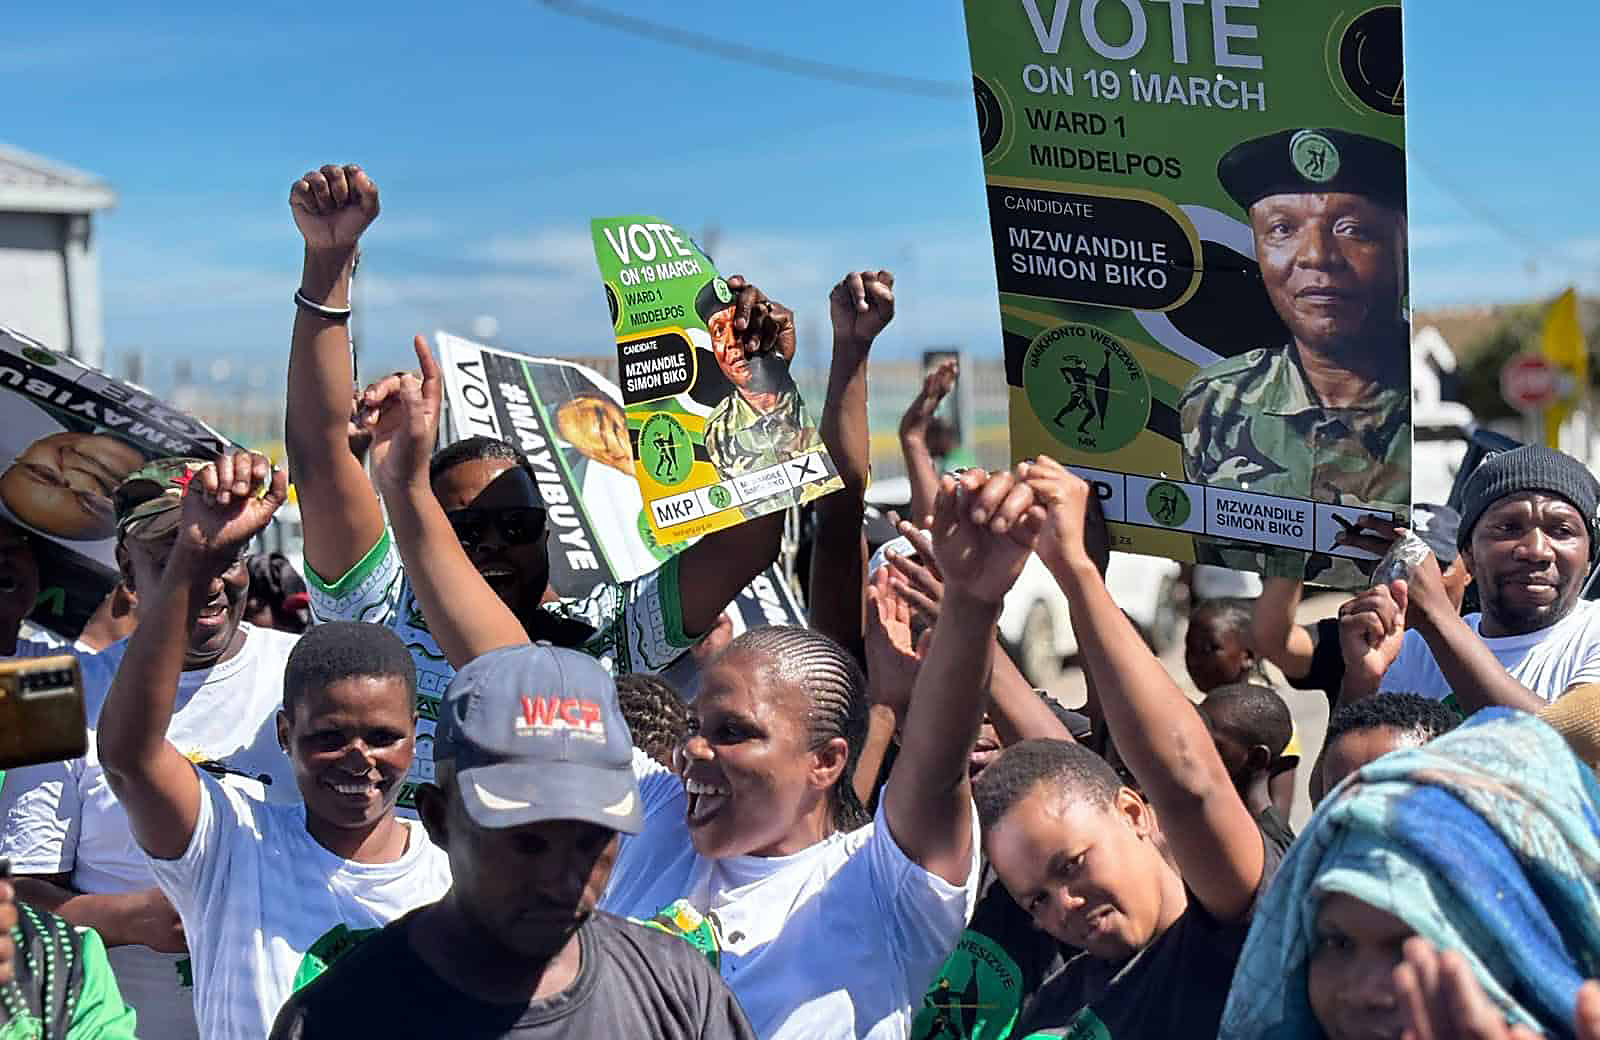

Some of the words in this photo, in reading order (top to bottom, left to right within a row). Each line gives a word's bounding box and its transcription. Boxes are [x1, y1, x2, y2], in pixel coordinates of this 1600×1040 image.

[1022, 0, 1264, 70] VOTE
[1023, 64, 1074, 97] ON
[1083, 68, 1121, 100] 19
[1132, 72, 1265, 112] MARCH
[1025, 108, 1107, 136] WARD
[1114, 115, 1127, 138] 1
[1030, 144, 1182, 179] MIDDELPOS
[1004, 195, 1095, 218] CANDIDATE
[604, 223, 692, 264] VOTE
[1008, 227, 1168, 264] MZWANDILE
[620, 267, 640, 286] ON
[640, 265, 656, 282] 19
[656, 261, 701, 280] MARCH
[1011, 253, 1096, 281] SIMON
[1105, 263, 1168, 290] BIKO
[625, 291, 656, 306] WARD
[630, 304, 685, 326] MIDDELPOS
[623, 341, 658, 355] CANDIDATE
[1090, 329, 1141, 382] WESIZWE
[625, 353, 686, 377] MZWANDILE
[626, 373, 662, 392] SIMON
[663, 368, 688, 384] BIKO
[457, 361, 497, 440] VOT
[499, 383, 599, 571] #MAYIBUYE
[656, 499, 694, 522] MKP
[1216, 498, 1305, 524] MZWANDILE
[1216, 513, 1264, 532] SIMON
[1268, 521, 1304, 538] BIKO
